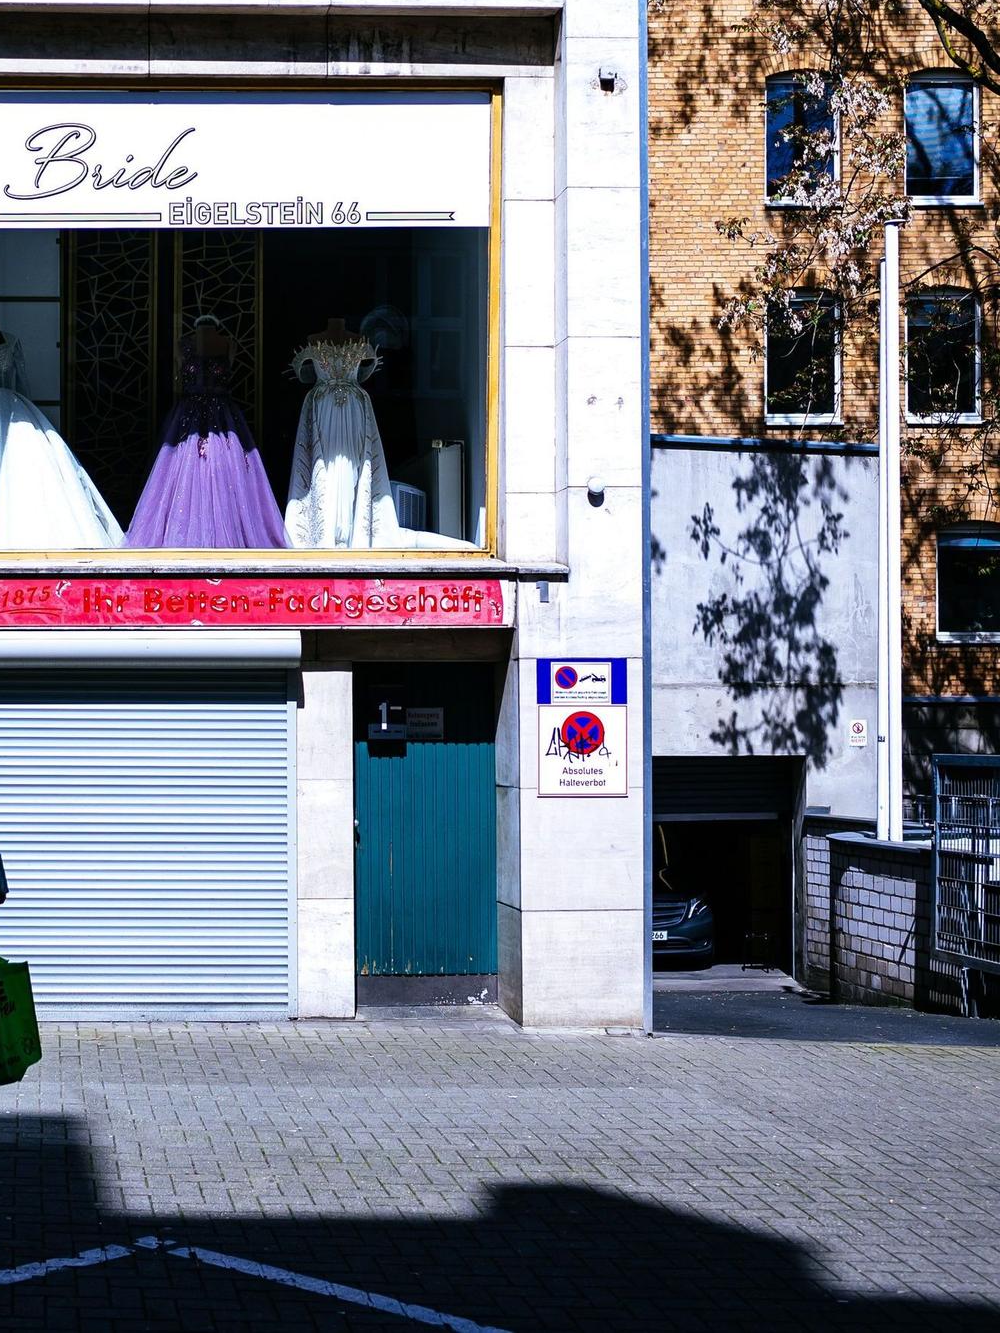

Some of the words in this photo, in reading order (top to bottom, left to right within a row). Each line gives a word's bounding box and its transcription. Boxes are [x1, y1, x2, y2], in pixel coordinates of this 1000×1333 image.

[3, 122, 198, 200] Bride
[331, 201, 362, 225] 66
[2, 585, 52, 608] 1875
[83, 587, 130, 613] Ihr
[143, 585, 485, 619] Betten-Fachgeschäft
[559, 778, 606, 787] Halteverbot
[562, 767, 604, 775] Absolutes
